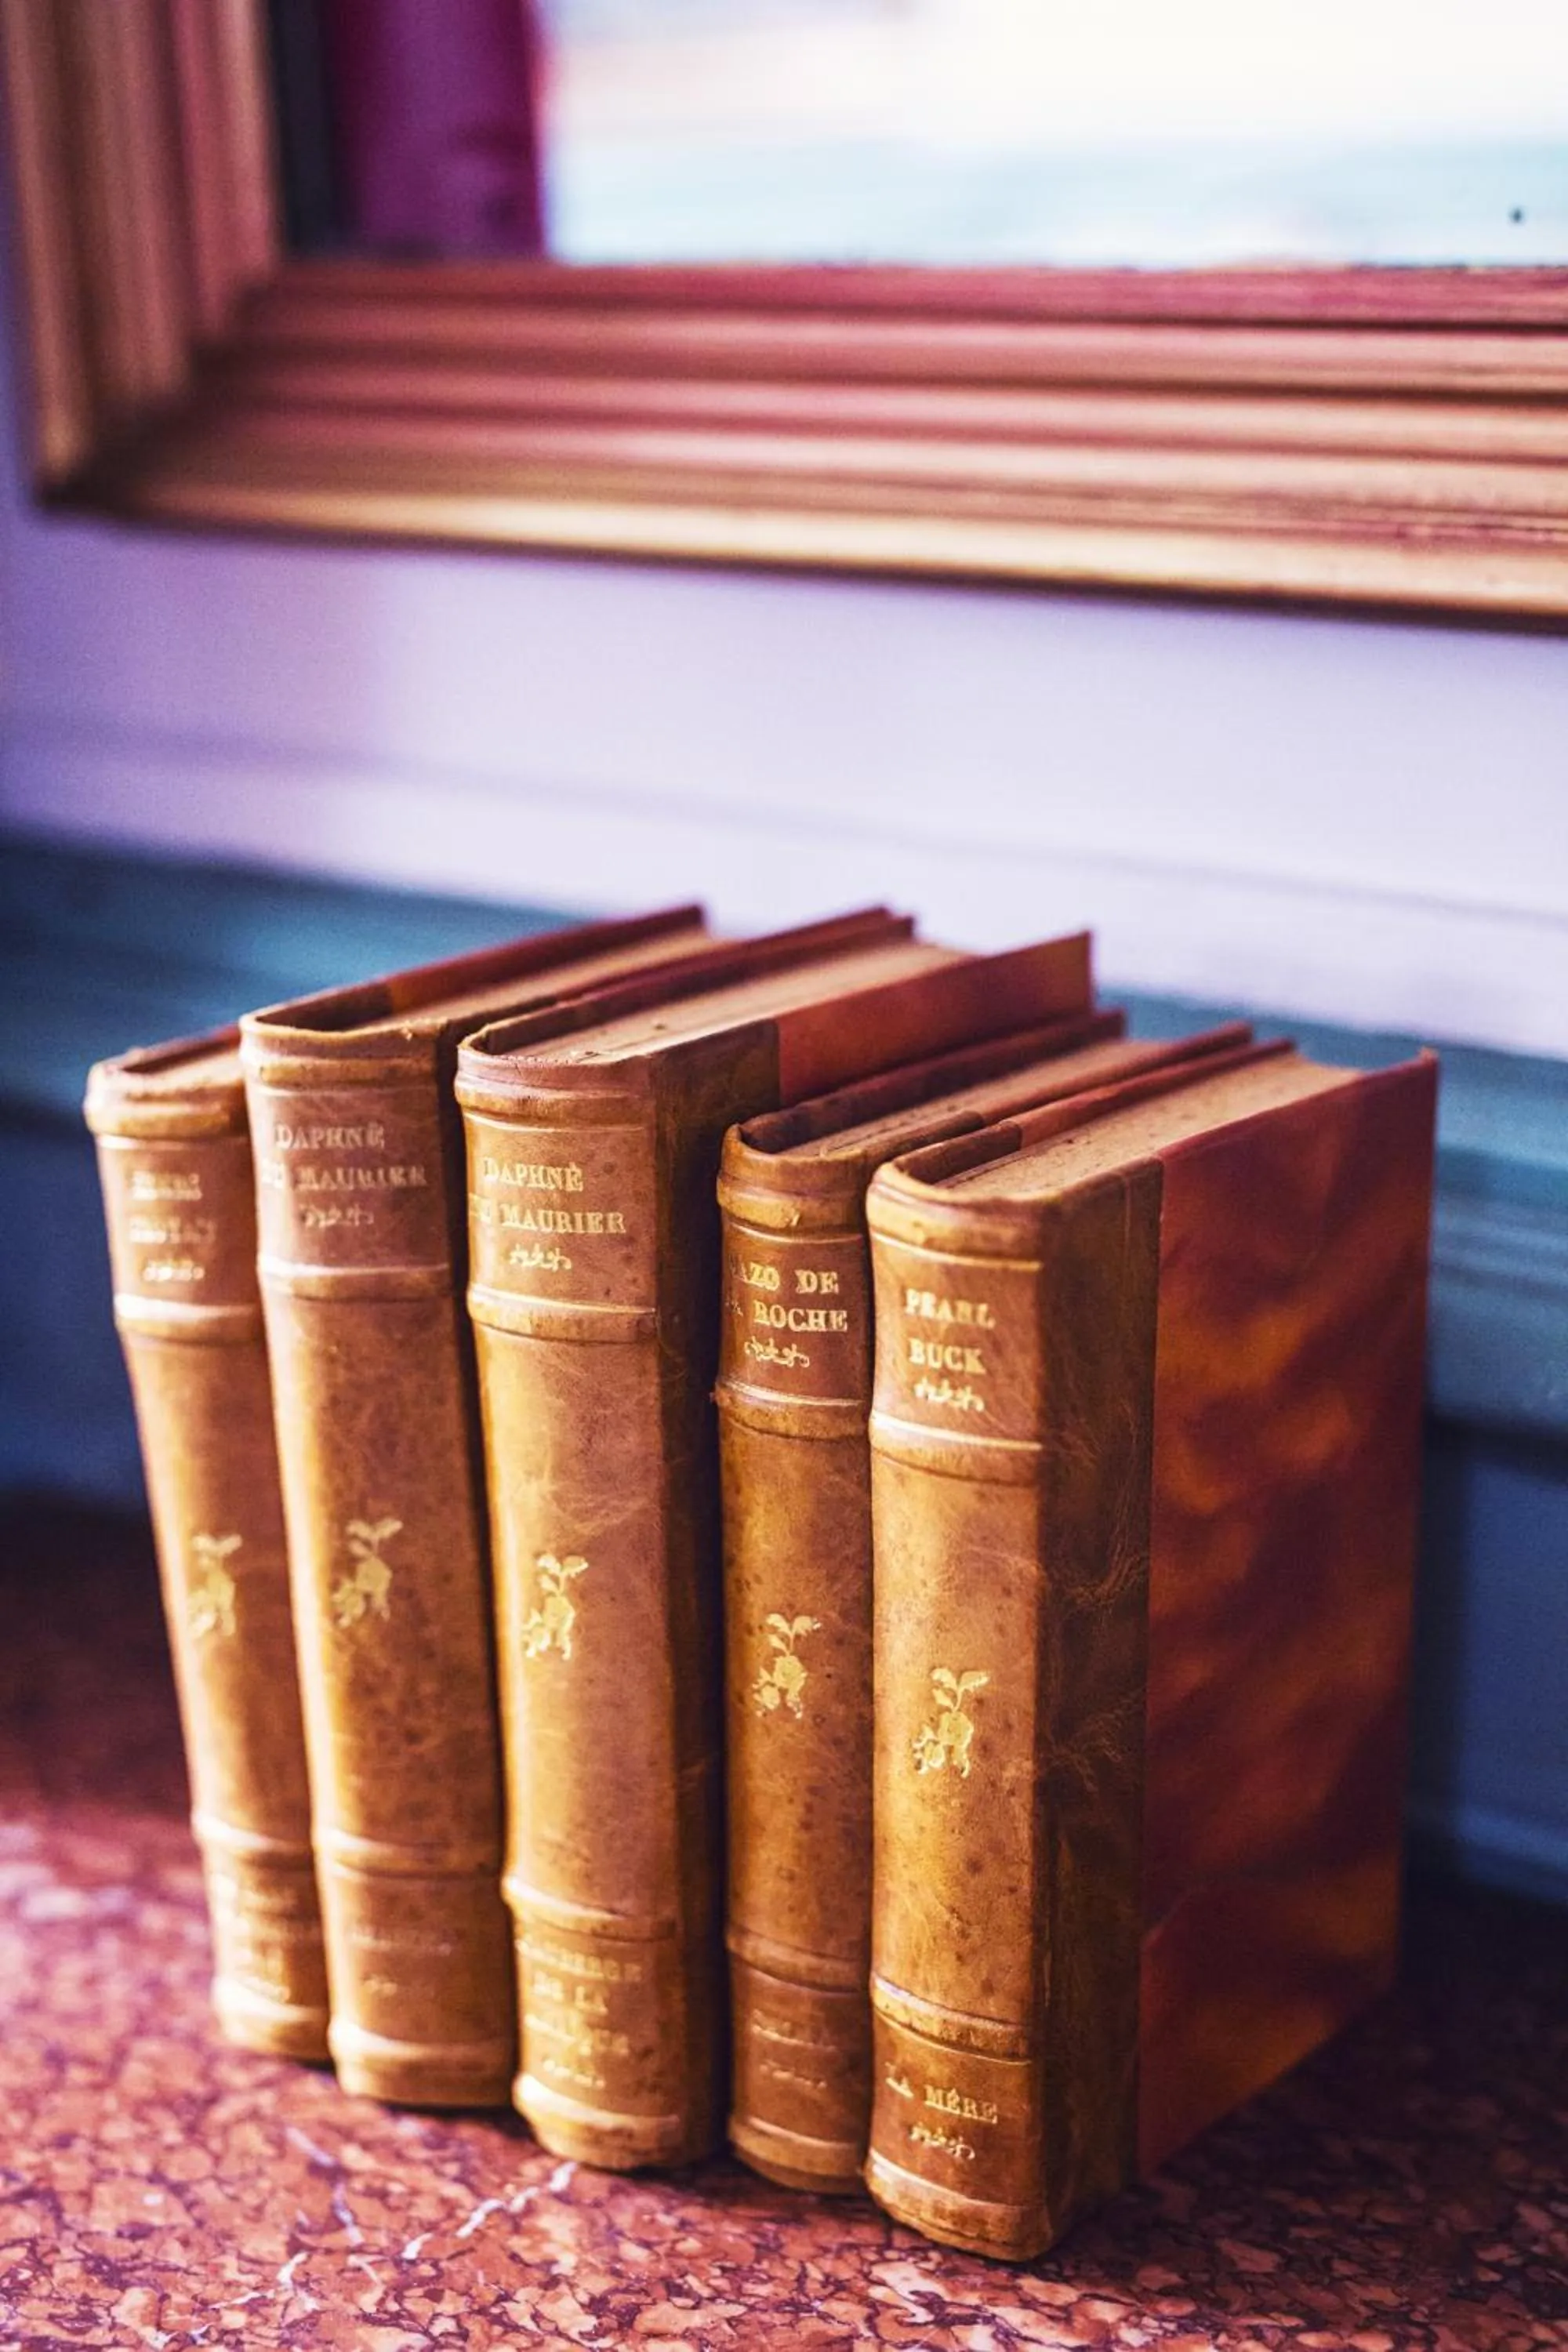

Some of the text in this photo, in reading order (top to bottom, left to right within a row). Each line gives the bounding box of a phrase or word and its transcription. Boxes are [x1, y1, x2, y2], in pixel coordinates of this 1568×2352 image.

[499, 1203, 626, 1234] MAURIER
[794, 1269, 840, 1295] DE
[753, 1298, 848, 1332] ROCHE
[909, 1338, 987, 1374] BUCK
